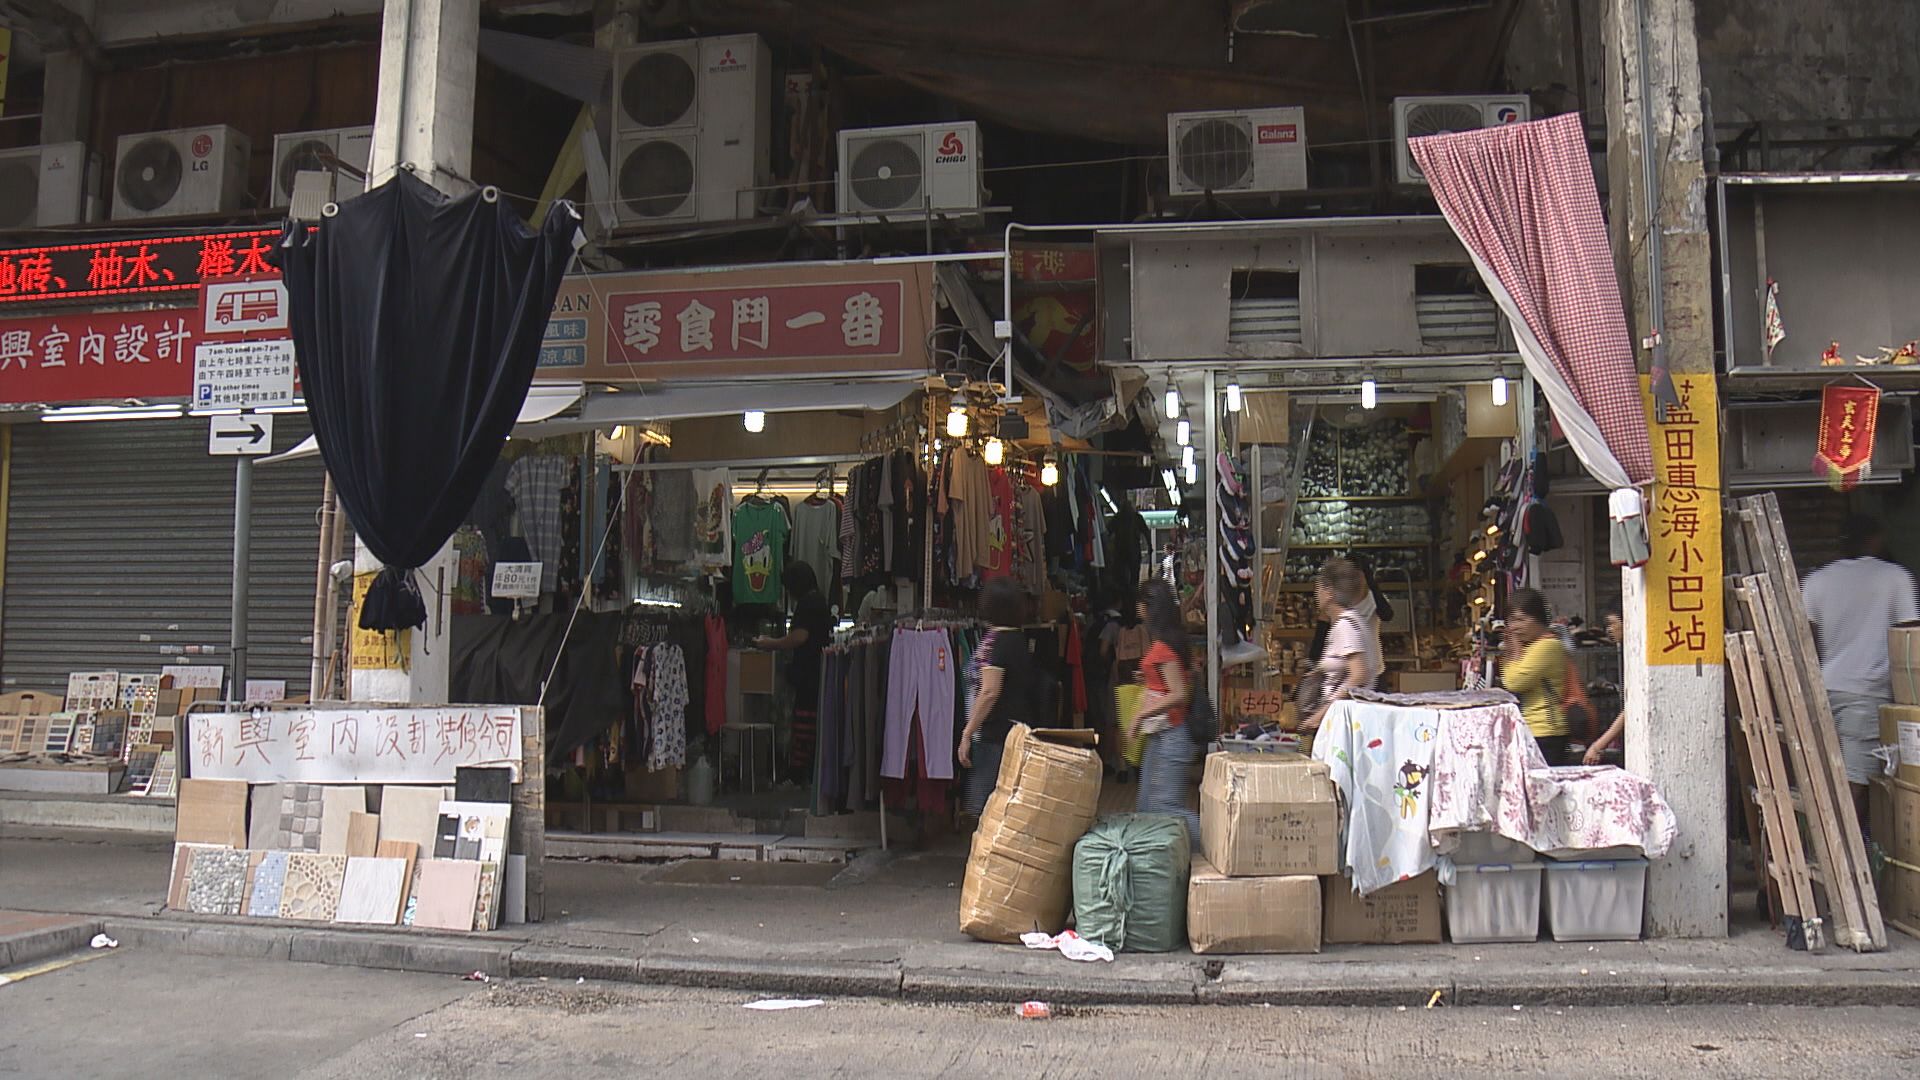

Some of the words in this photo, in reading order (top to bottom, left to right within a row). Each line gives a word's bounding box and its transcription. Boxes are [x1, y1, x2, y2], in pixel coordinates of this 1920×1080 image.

[1259, 128, 1295, 140] Galanz
[935, 154, 967, 164] CHIGO
[192, 160, 209, 172] LG
[199, 353, 290, 368] 由上午七時至上午十時
[198, 366, 290, 380] 由下午四時至下午七時
[223, 383, 241, 391] other
[241, 382, 260, 390] times
[1242, 695, 1280, 714] $45
